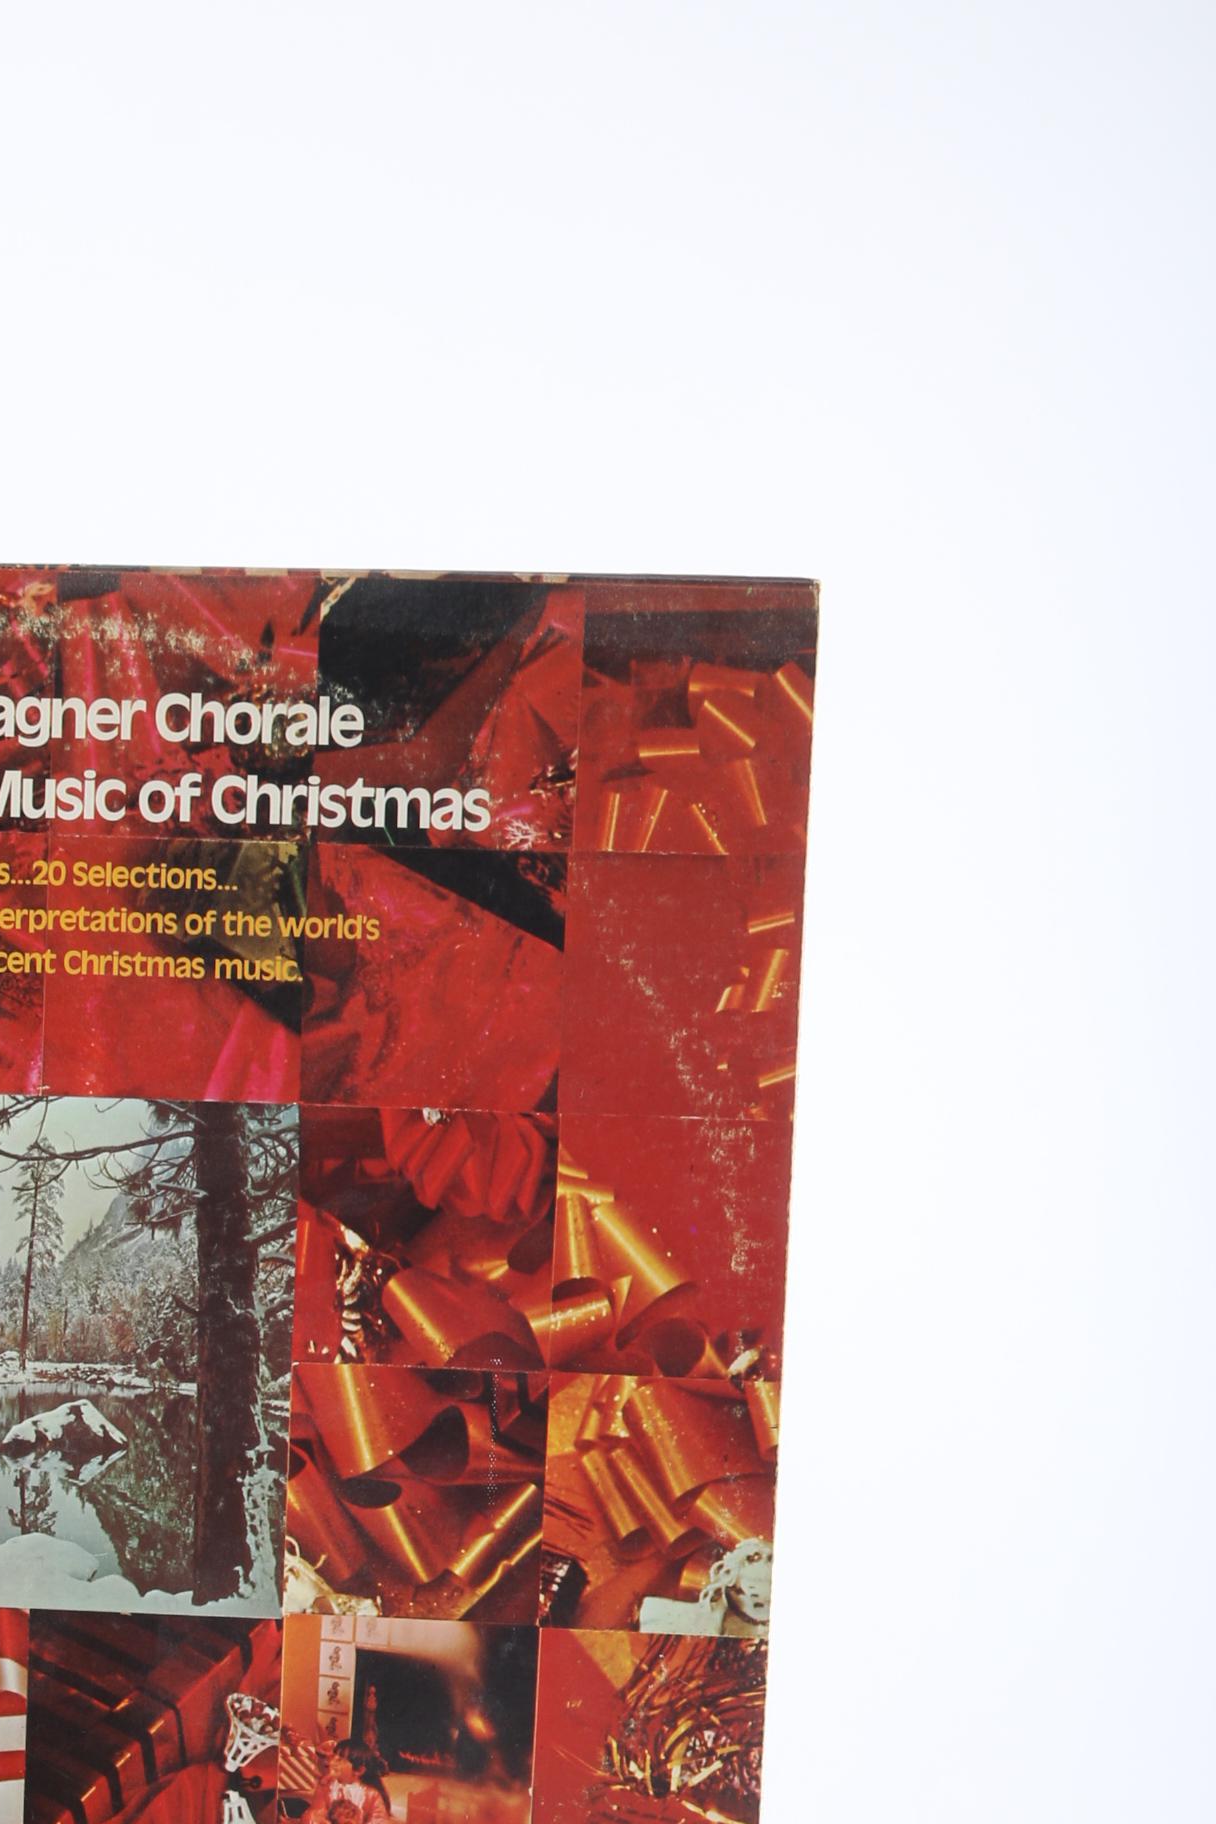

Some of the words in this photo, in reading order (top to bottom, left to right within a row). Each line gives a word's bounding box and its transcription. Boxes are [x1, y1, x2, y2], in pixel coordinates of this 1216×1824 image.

[155, 693, 364, 748] Chorale
[139, 773, 199, 823] of
[211, 773, 491, 832] Christmas
[72, 861, 239, 892] Selections...
[184, 910, 217, 935] of
[223, 911, 272, 937] the
[278, 912, 381, 941] world's
[64, 949, 205, 979] Christmas
[214, 951, 304, 982] music.
